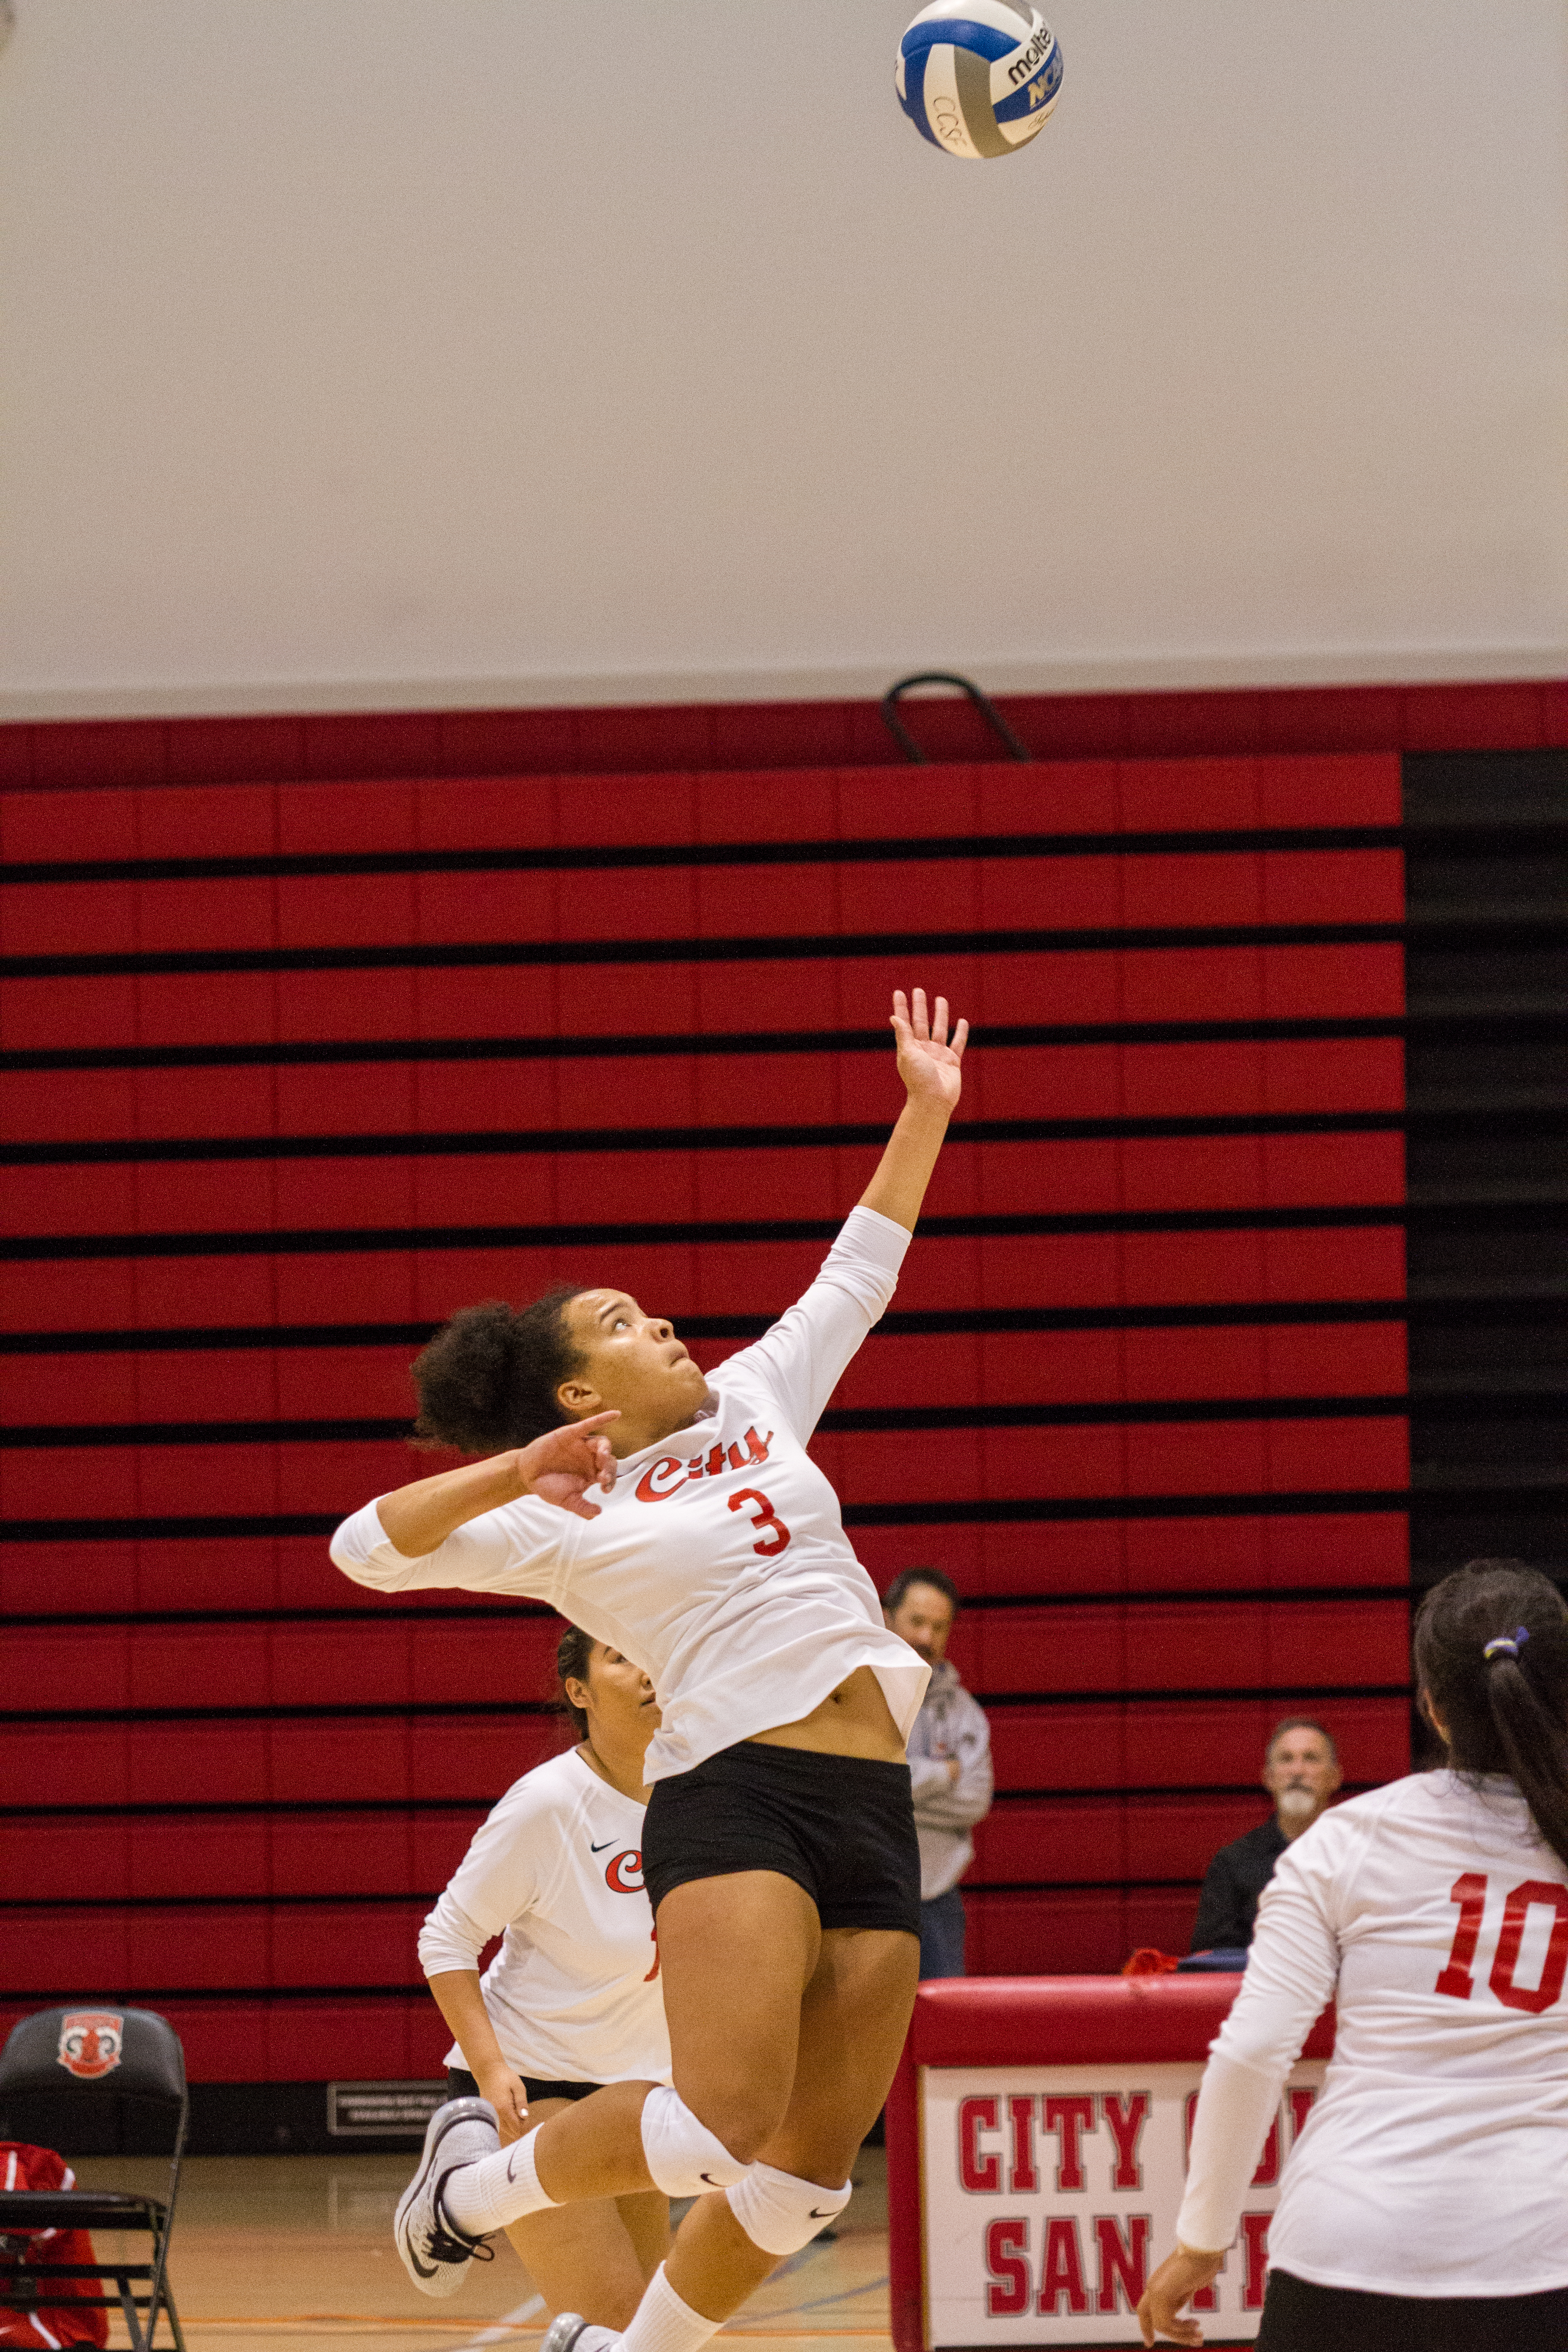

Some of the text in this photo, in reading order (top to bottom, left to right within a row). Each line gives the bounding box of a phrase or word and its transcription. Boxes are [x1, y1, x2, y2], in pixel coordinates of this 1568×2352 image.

[1008, 27, 1051, 85] molte
[635, 1426, 774, 1503] City
[727, 1488, 791, 1557] 3
[1435, 1872, 1568, 2014] 10
[958, 2089, 1152, 2194] CITY
[984, 2214, 1152, 2318] SAN
